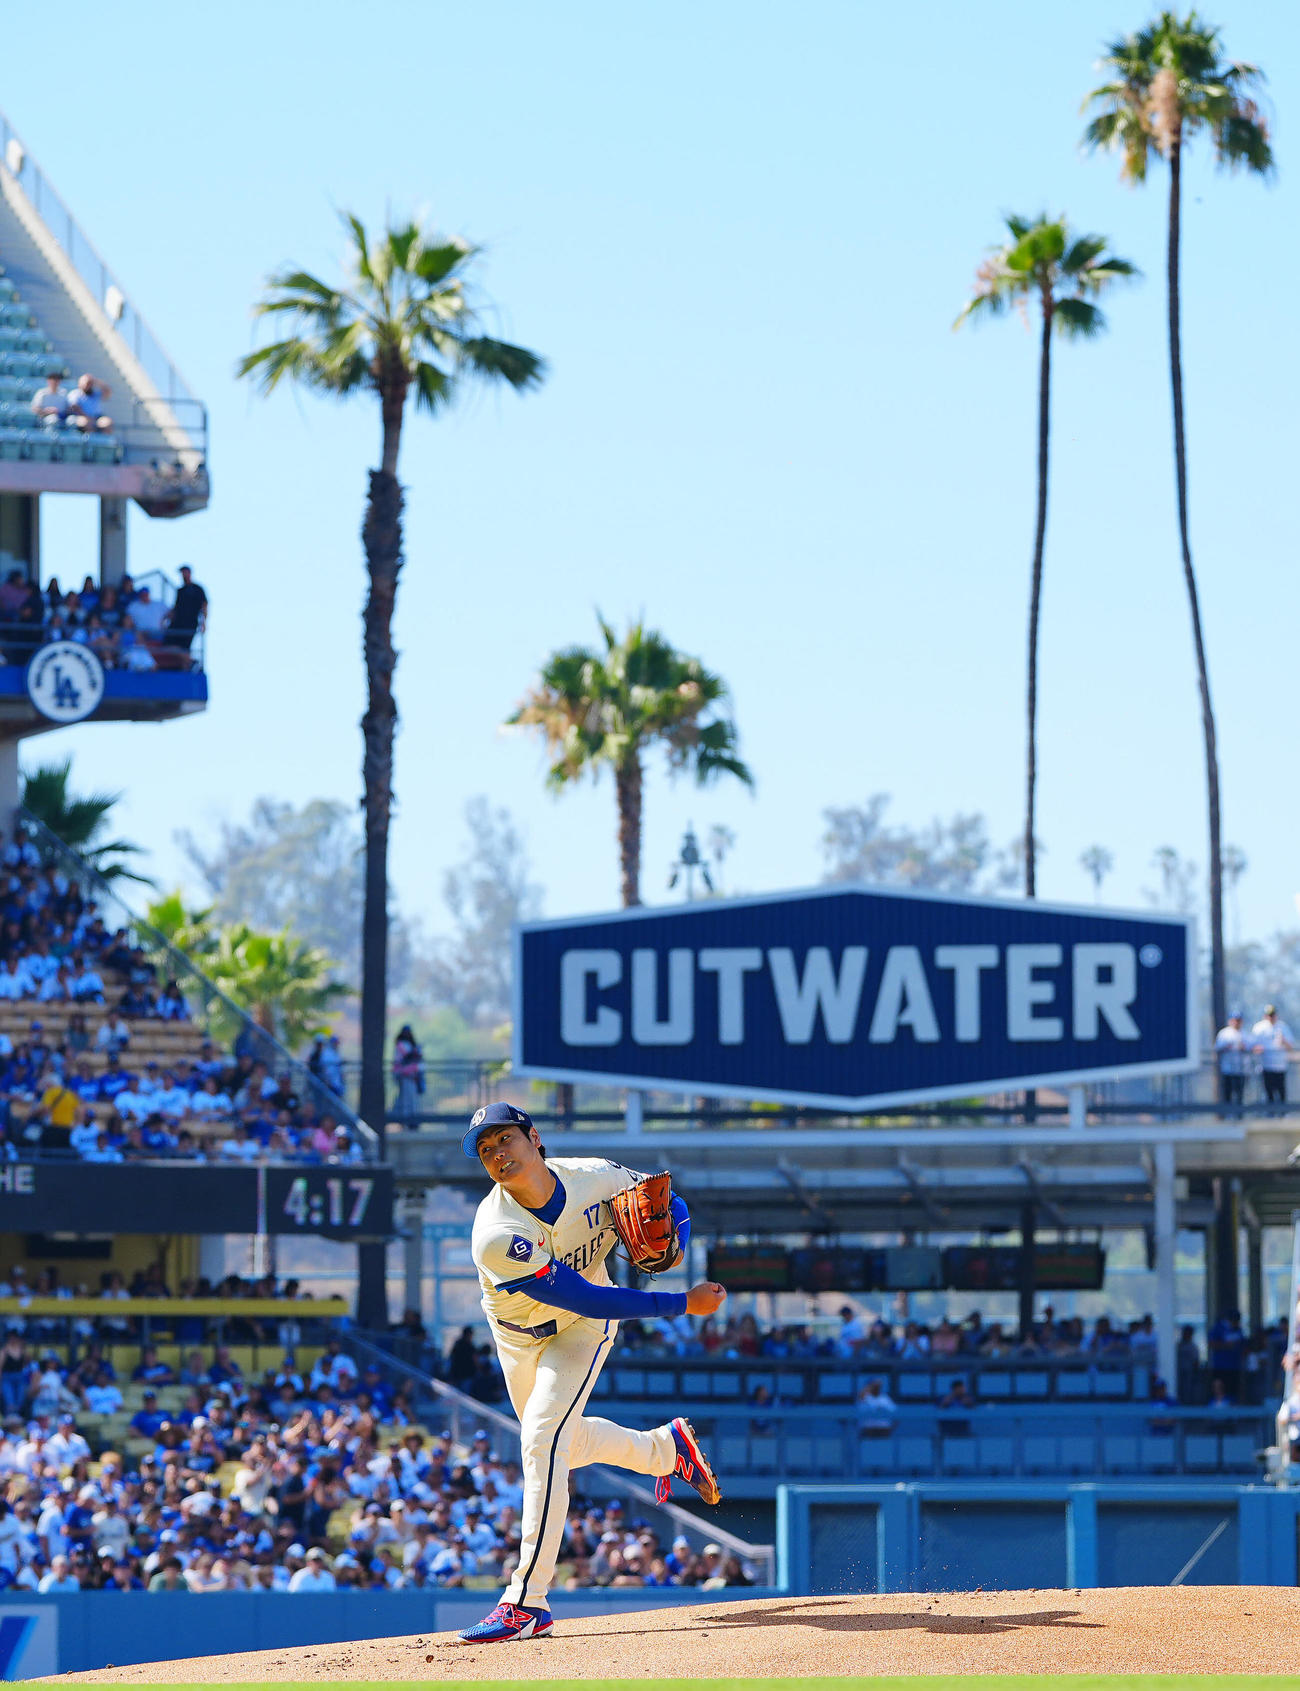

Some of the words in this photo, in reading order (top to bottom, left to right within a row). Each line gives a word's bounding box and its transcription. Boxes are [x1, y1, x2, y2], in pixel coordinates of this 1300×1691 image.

[560, 942, 1141, 1047] CUTWATER
[283, 1178, 374, 1226] 4:17
[583, 1202, 600, 1229] 17
